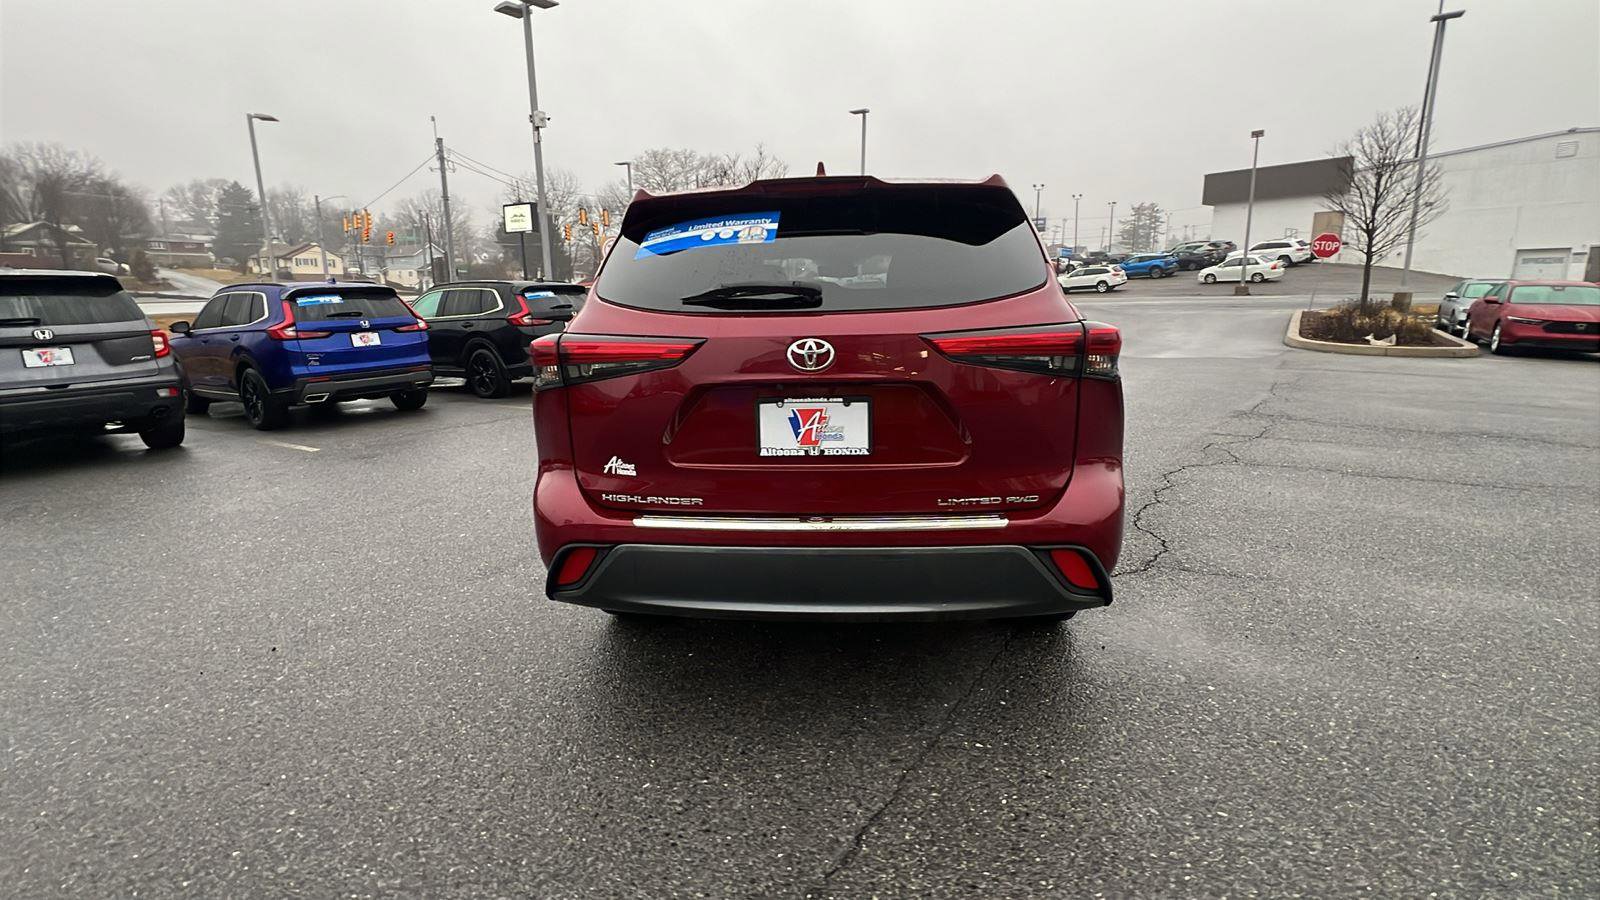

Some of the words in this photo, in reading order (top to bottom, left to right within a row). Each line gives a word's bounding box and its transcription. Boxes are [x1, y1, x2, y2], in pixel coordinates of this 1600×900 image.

[688, 221, 723, 231] Limited
[725, 217, 771, 227] Warranty
[1314, 240, 1340, 250] STOP
[759, 446, 805, 456] Altoona
[824, 447, 870, 456] HONDA
[601, 493, 704, 506] HIGHLANDER
[937, 496, 1002, 506] LIMITED
